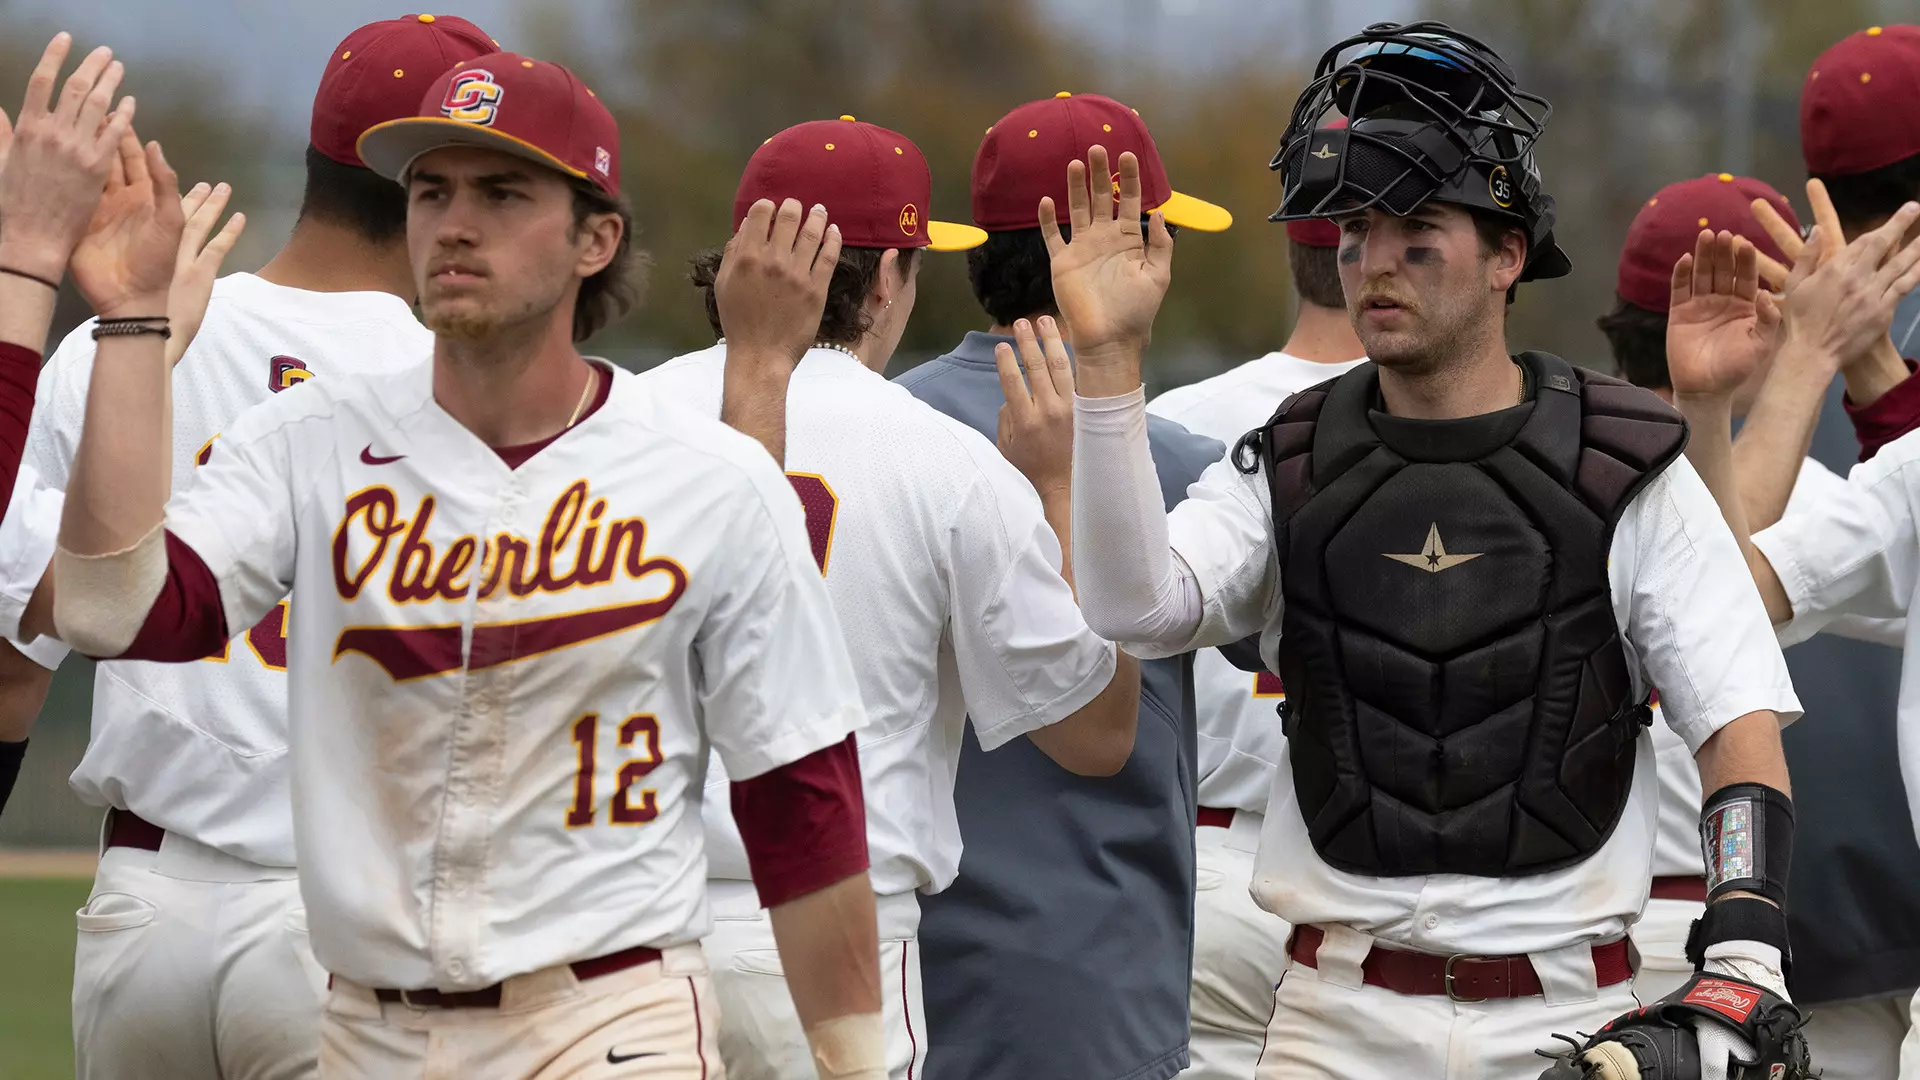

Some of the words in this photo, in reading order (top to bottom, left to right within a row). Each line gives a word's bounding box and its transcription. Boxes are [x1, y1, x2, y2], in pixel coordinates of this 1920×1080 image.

[902, 212, 917, 225] AA
[1495, 180, 1510, 199] 35
[332, 479, 652, 605] Oberlin
[564, 712, 664, 829] 12
